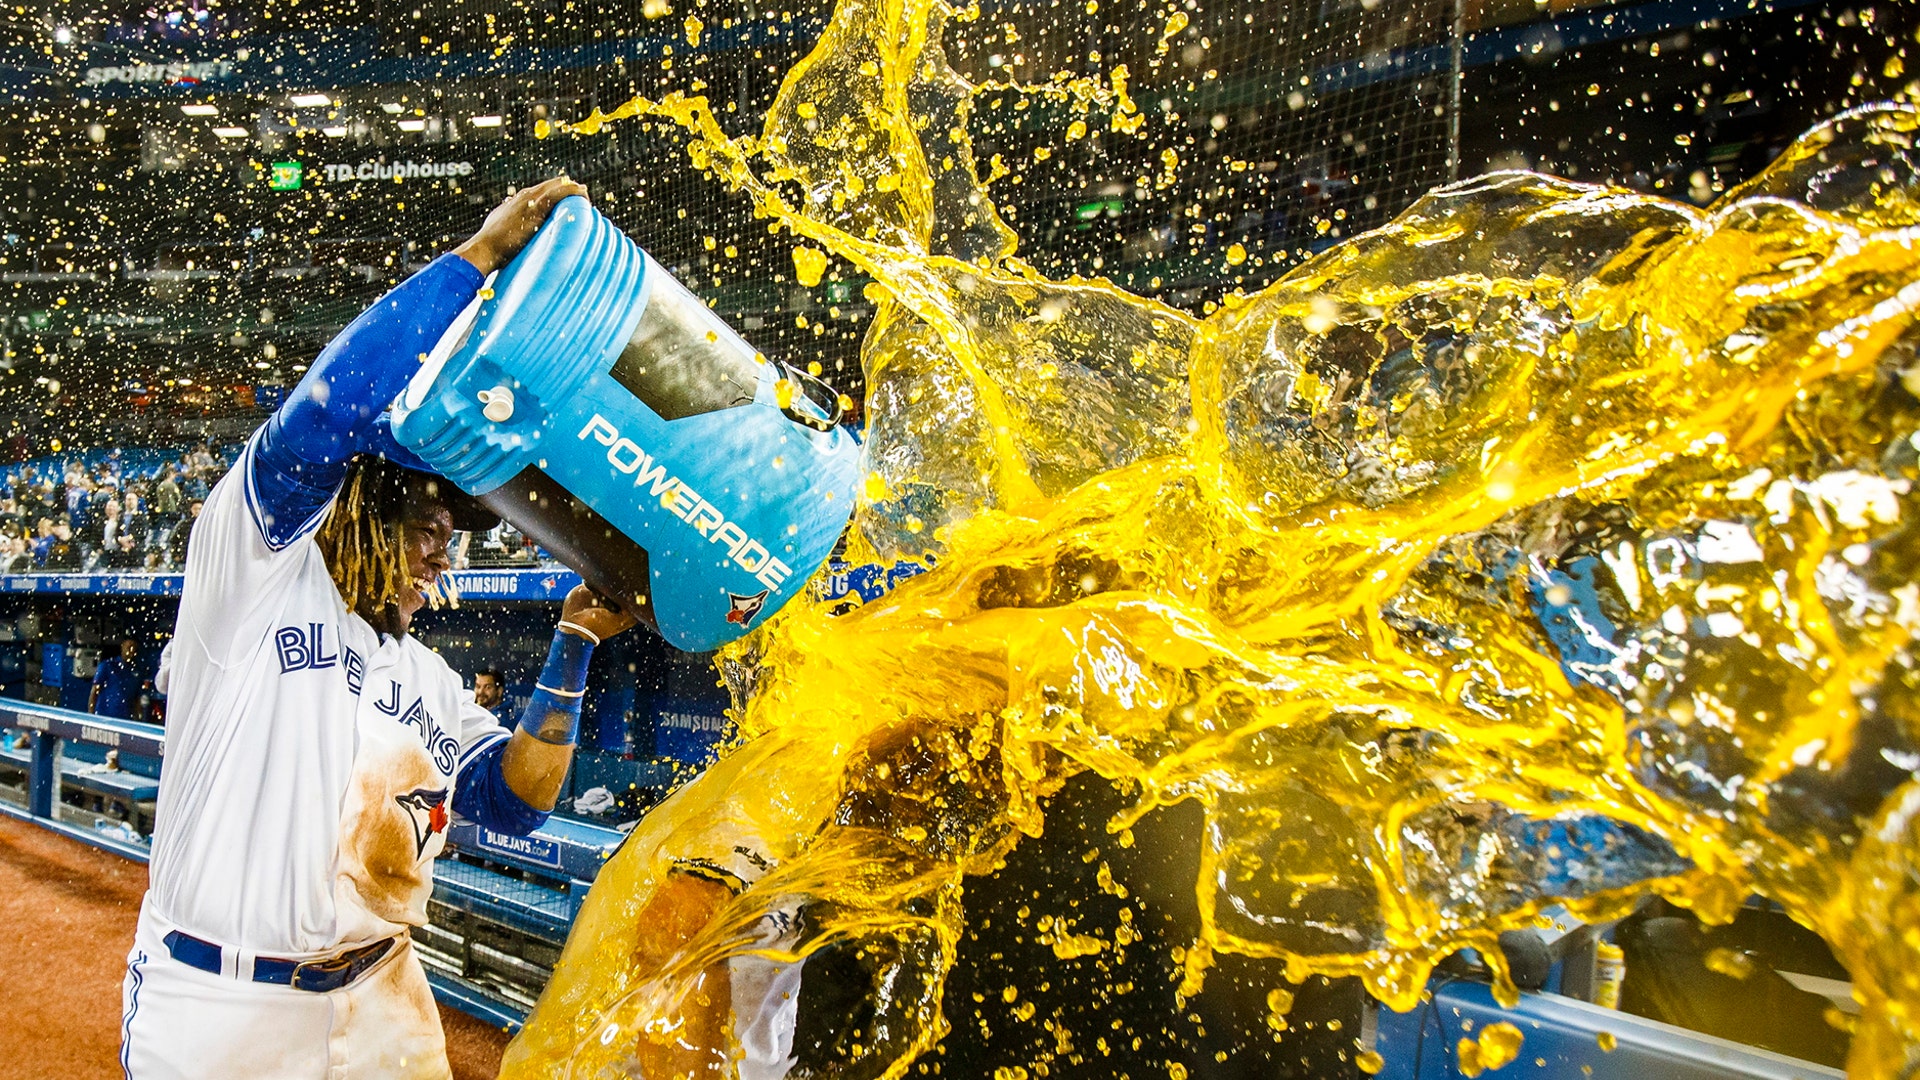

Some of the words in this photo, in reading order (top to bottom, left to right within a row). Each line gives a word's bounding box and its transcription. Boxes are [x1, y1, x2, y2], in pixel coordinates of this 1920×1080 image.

[85, 61, 233, 85] SPORTSNET
[324, 163, 352, 182] TD
[357, 159, 472, 181] Clubhouse
[577, 413, 793, 592] POWERADE
[457, 576, 518, 594] SAMSUNG
[275, 623, 364, 696] BLE
[81, 725, 121, 747] SAMSUNG
[373, 680, 461, 777] JAYS
